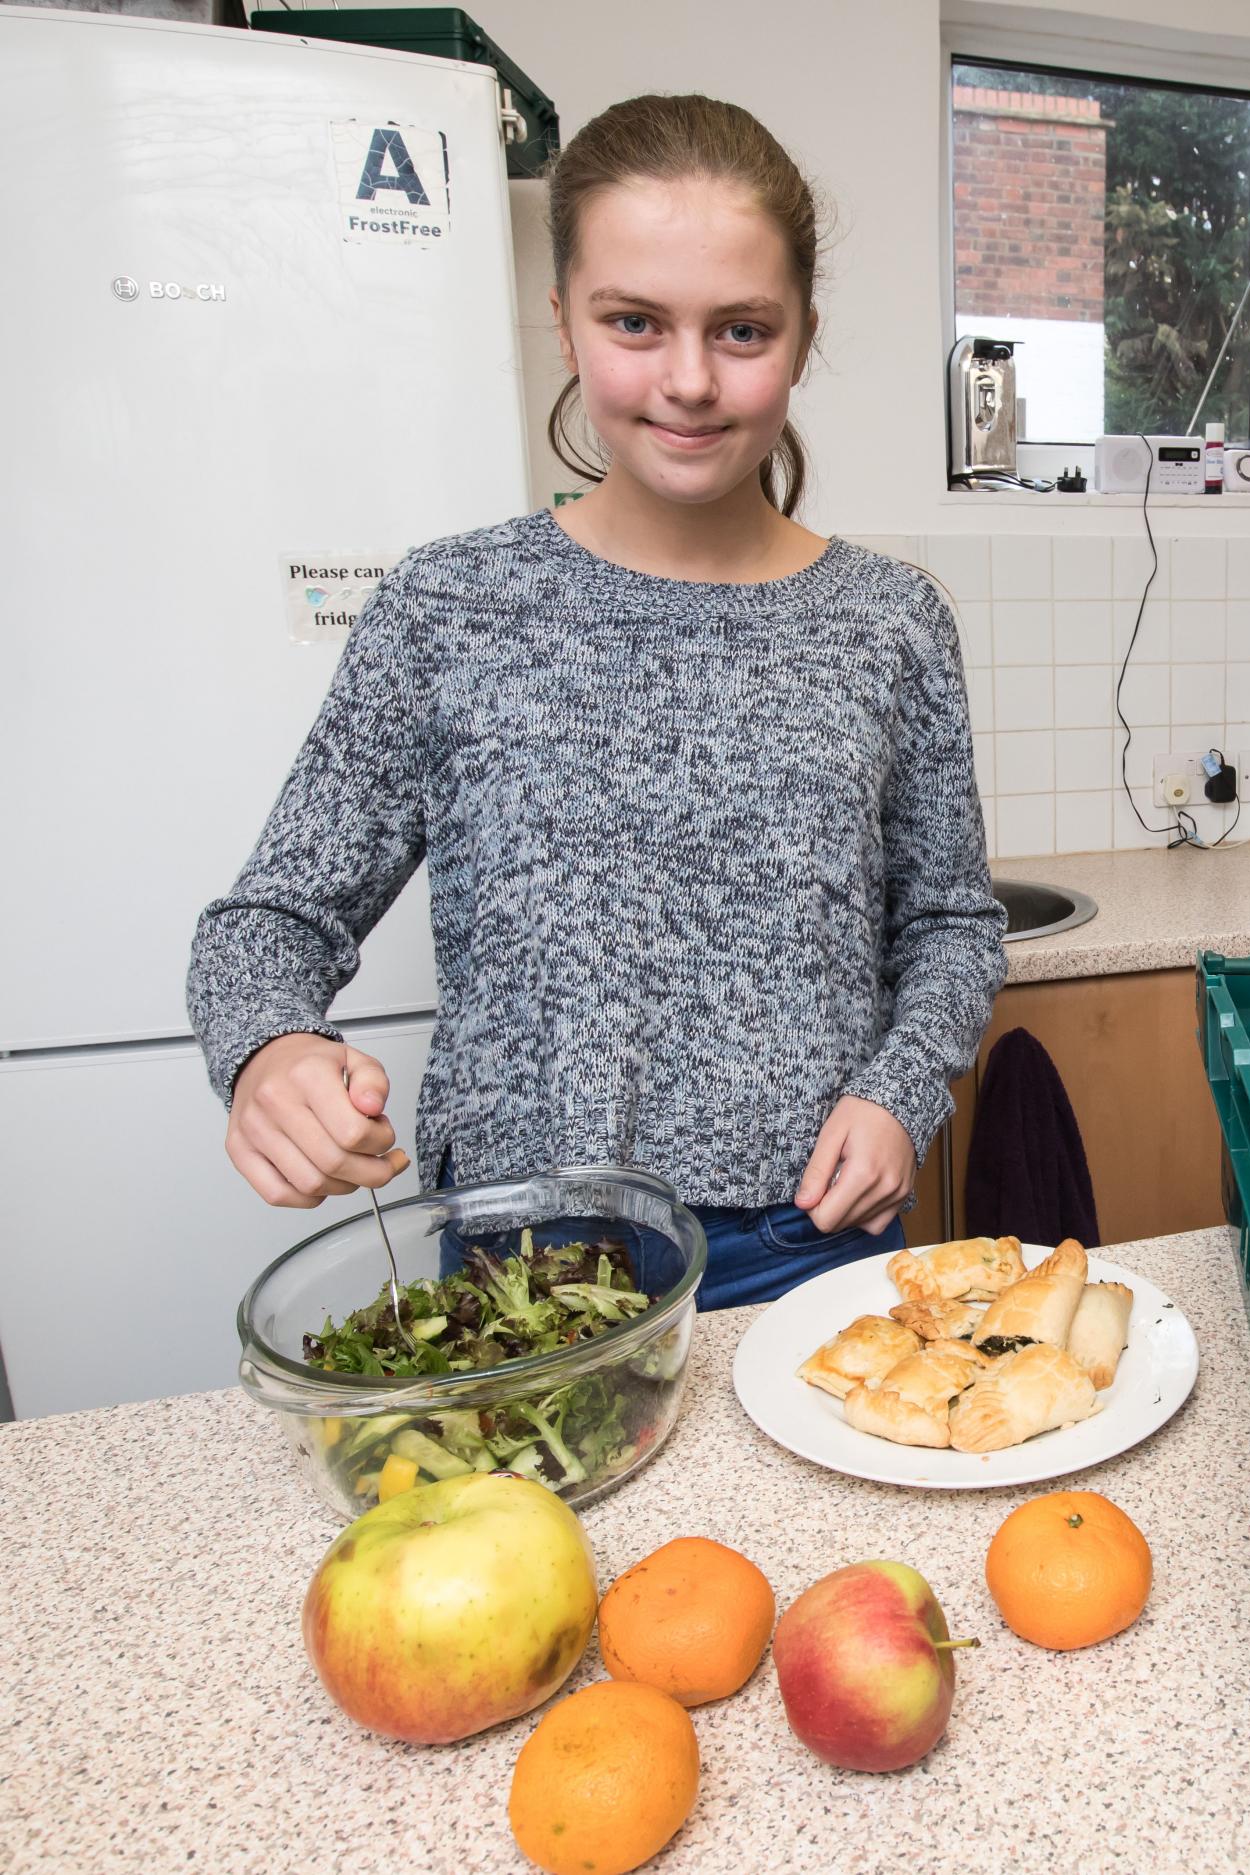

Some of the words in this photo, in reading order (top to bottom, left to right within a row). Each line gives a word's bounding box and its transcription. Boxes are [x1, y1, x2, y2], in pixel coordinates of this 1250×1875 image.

[356, 128, 431, 206] A
[369, 206, 420, 219] electronic
[349, 216, 442, 237] FrostFree
[149, 281, 226, 302] BOCH
[290, 564, 349, 580] Please
[354, 567, 384, 579] can
[314, 611, 360, 629] fridg
